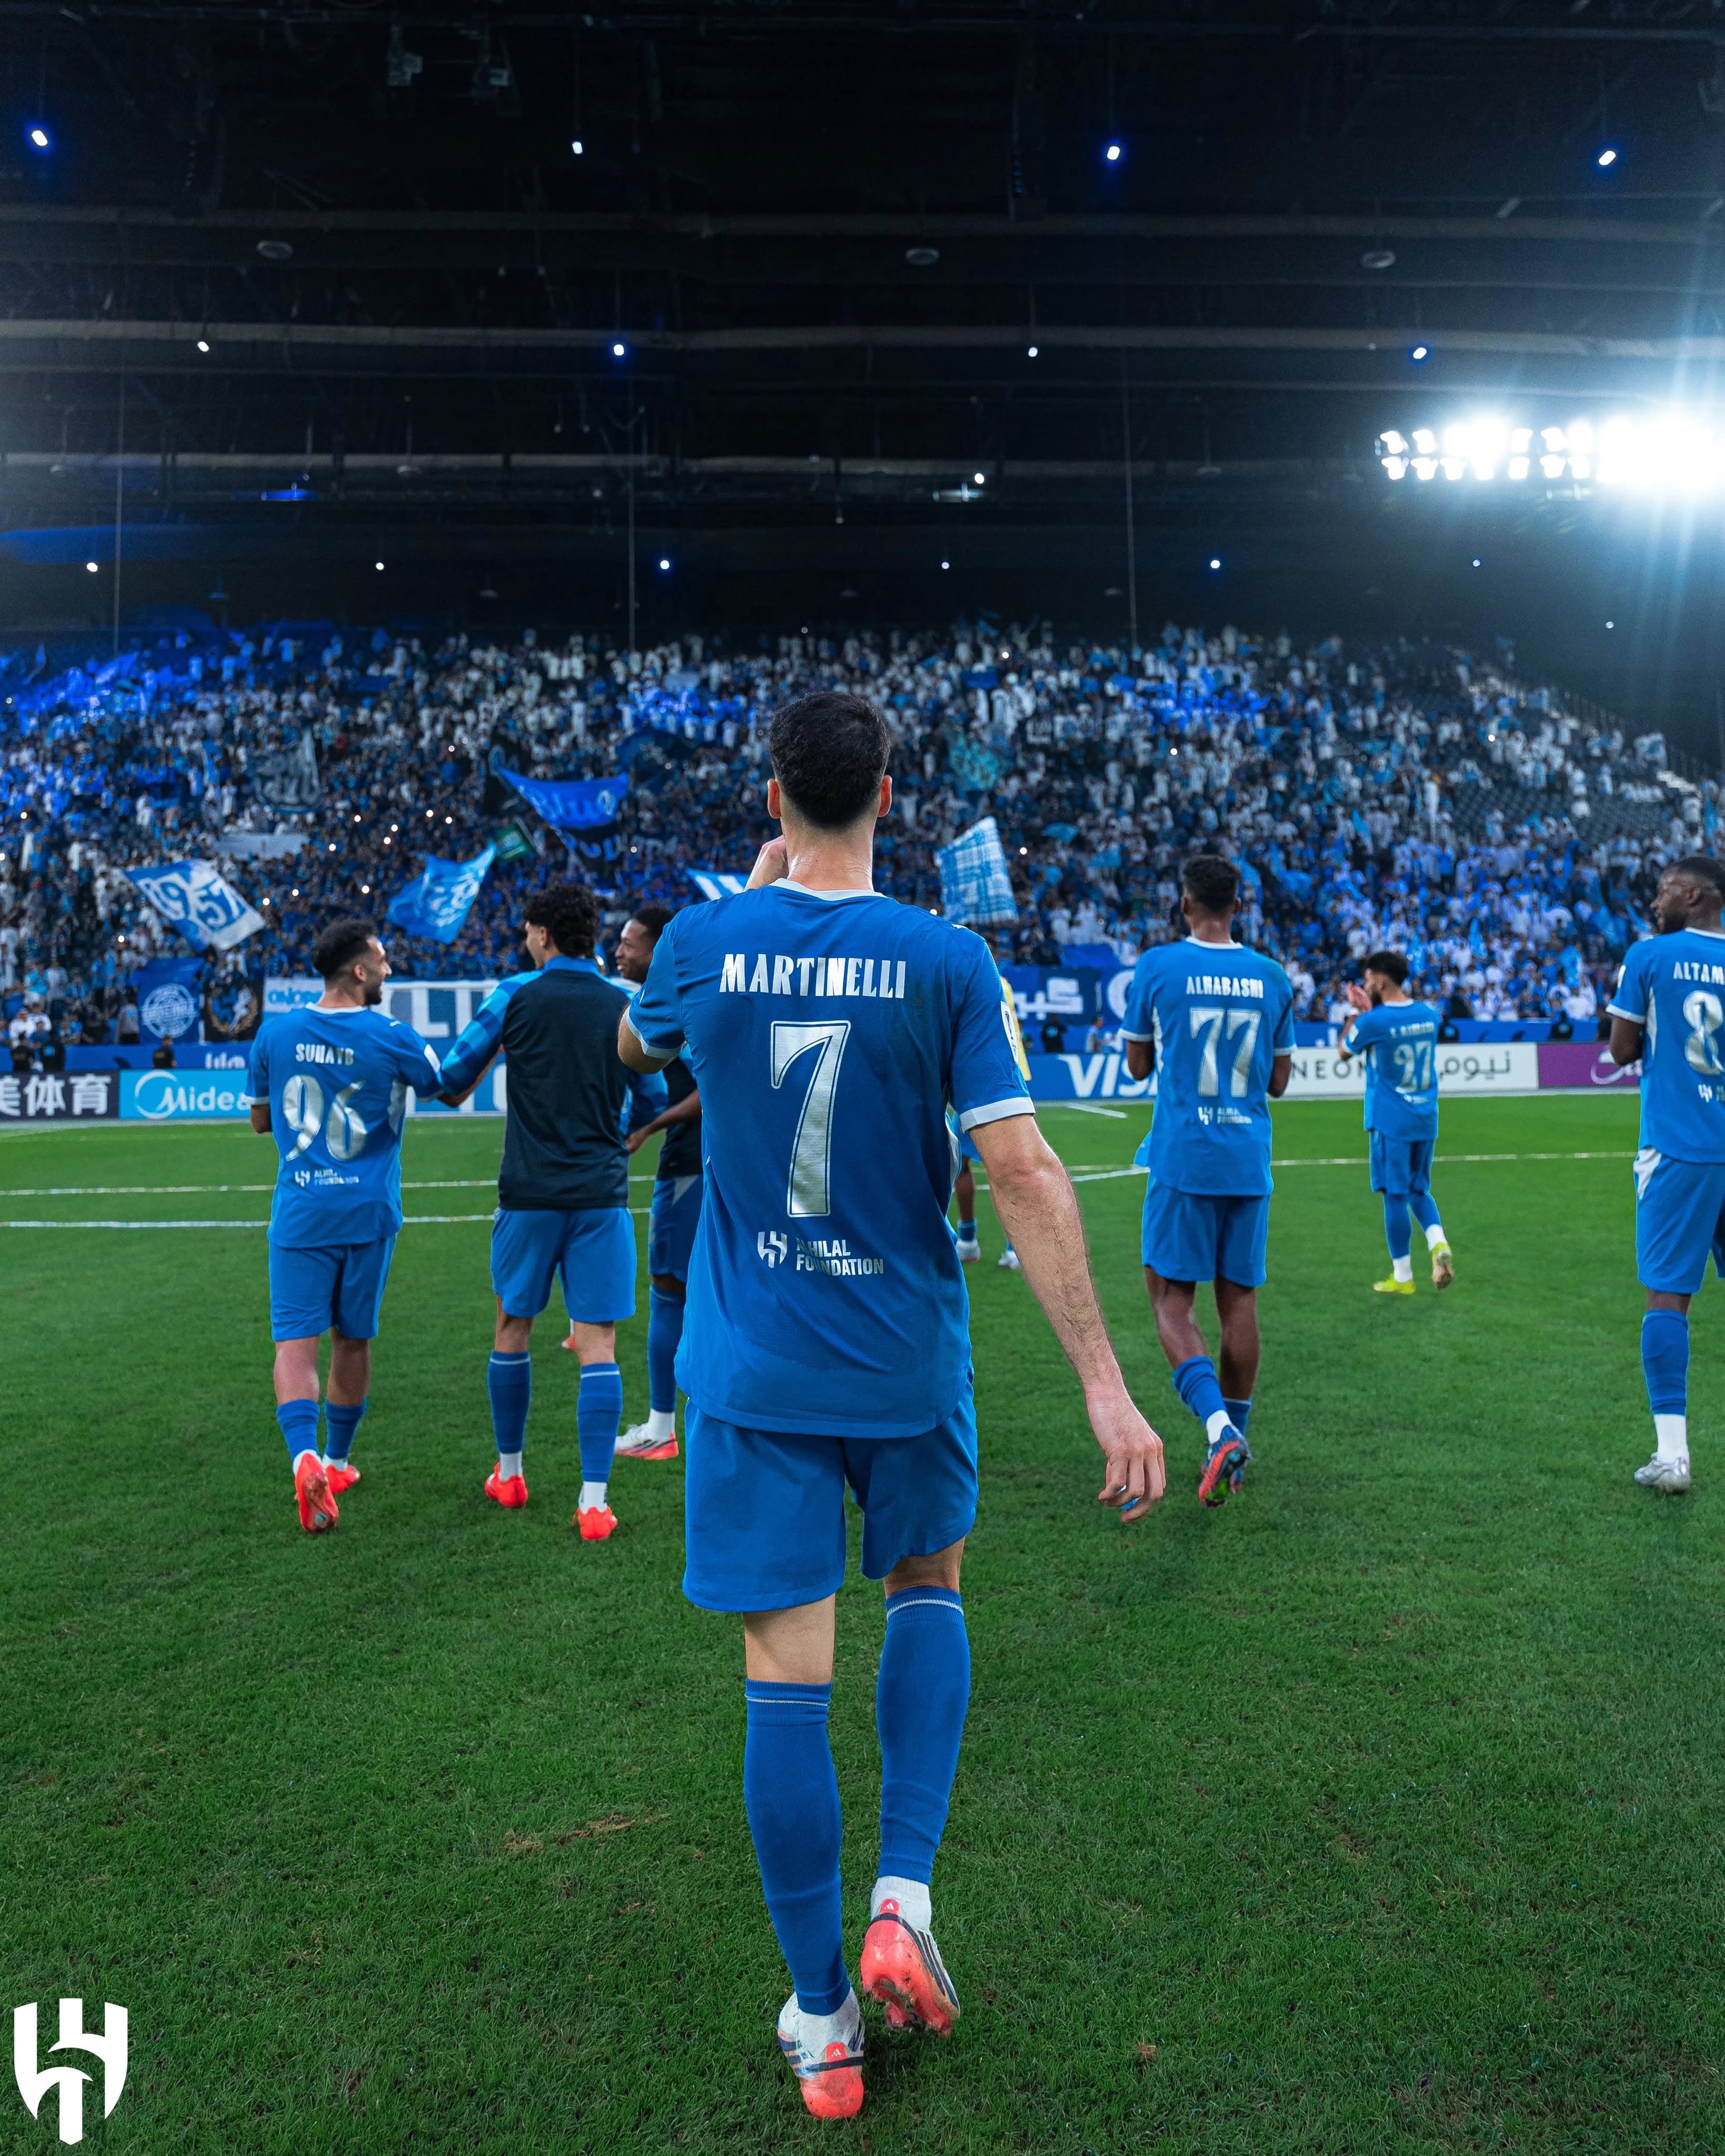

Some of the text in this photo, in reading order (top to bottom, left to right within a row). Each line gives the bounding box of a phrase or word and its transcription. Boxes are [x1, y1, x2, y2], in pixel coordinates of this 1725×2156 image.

[719, 953, 906, 999] MARTINELLI
[1186, 975, 1263, 999] ALHABASHI
[1673, 961, 1725, 985] ALTAM
[295, 1043, 354, 1065] SUHAYB
[1189, 1007, 1262, 1098] 77
[283, 1074, 367, 1162] 96
[771, 1020, 851, 1217] 7
[796, 1254, 884, 1276] FOUNDATION
